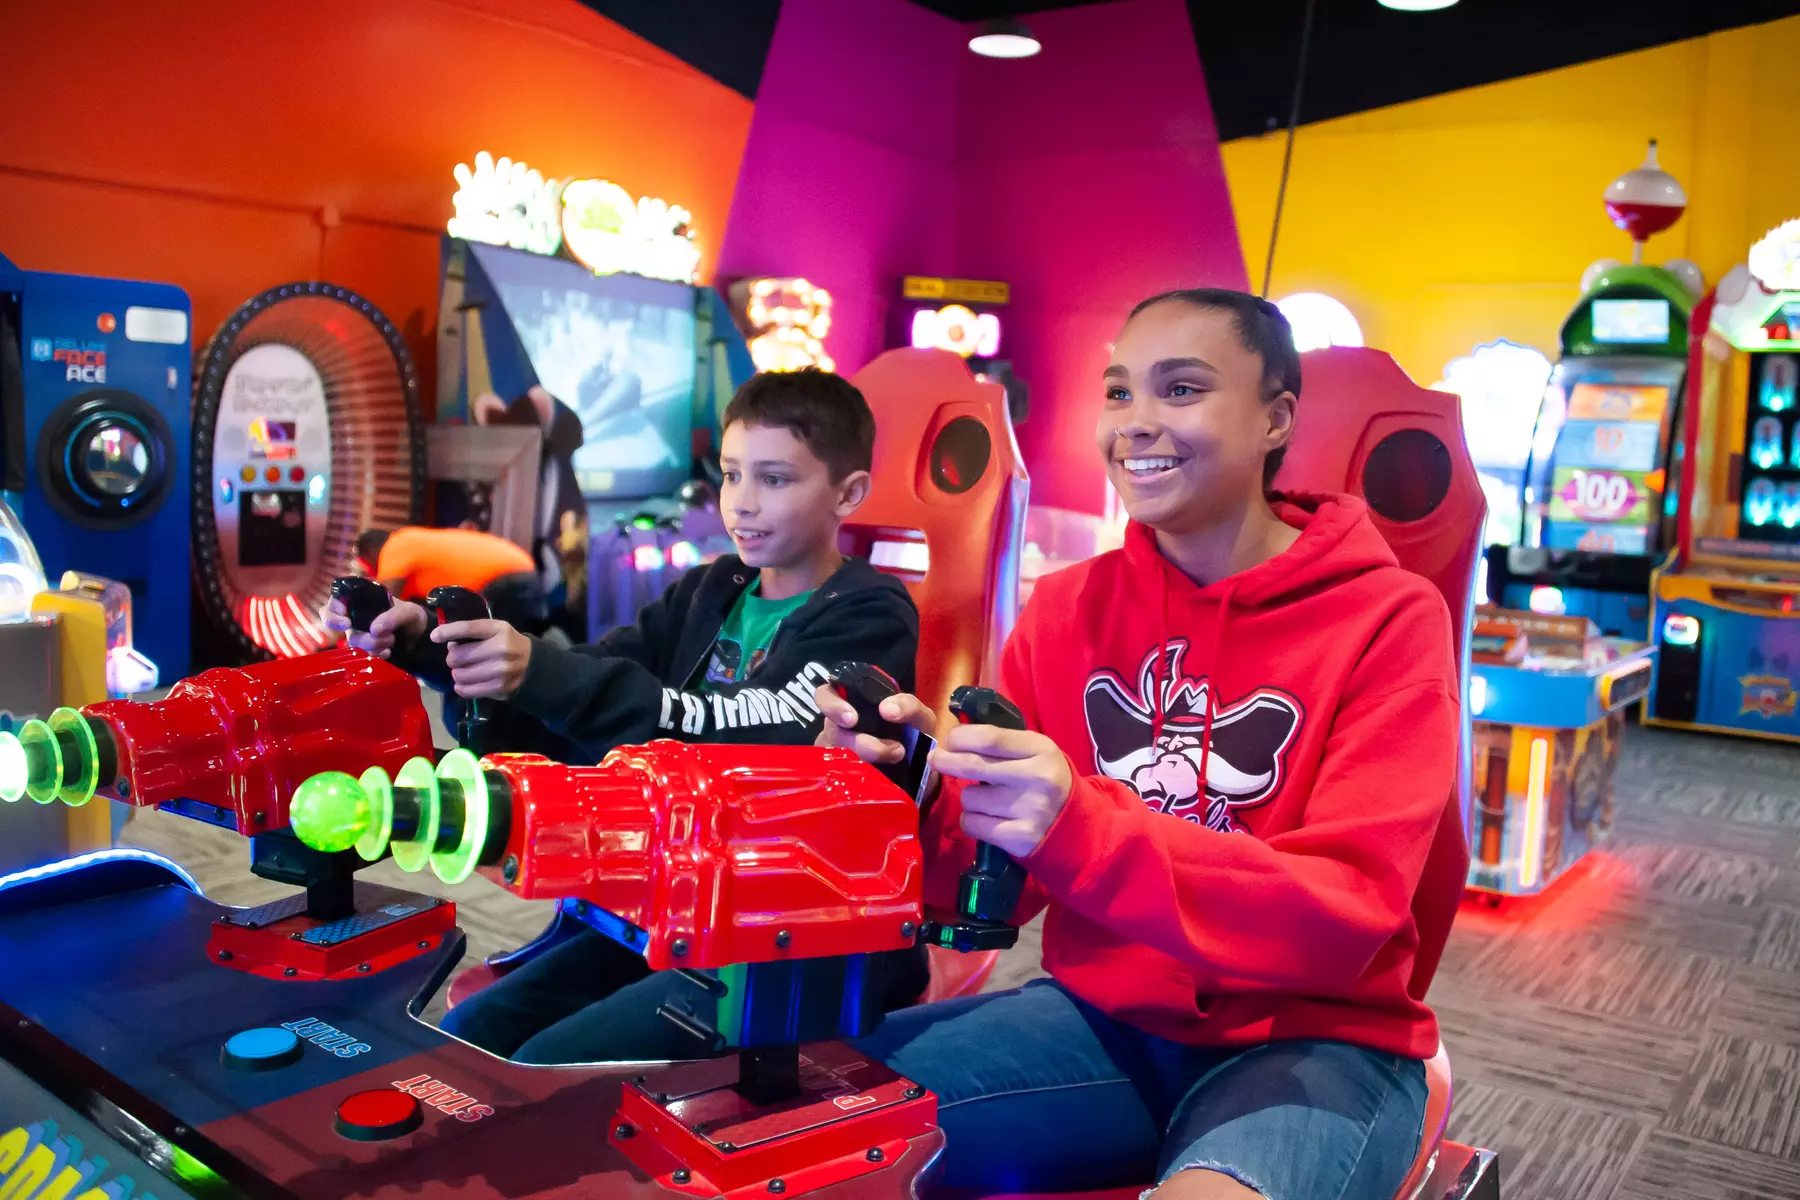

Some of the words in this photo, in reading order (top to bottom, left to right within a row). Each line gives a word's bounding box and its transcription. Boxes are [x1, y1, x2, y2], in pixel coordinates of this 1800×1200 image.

[1573, 469, 1629, 512] 100
[280, 1017, 372, 1059] START
[393, 1074, 496, 1123] START
